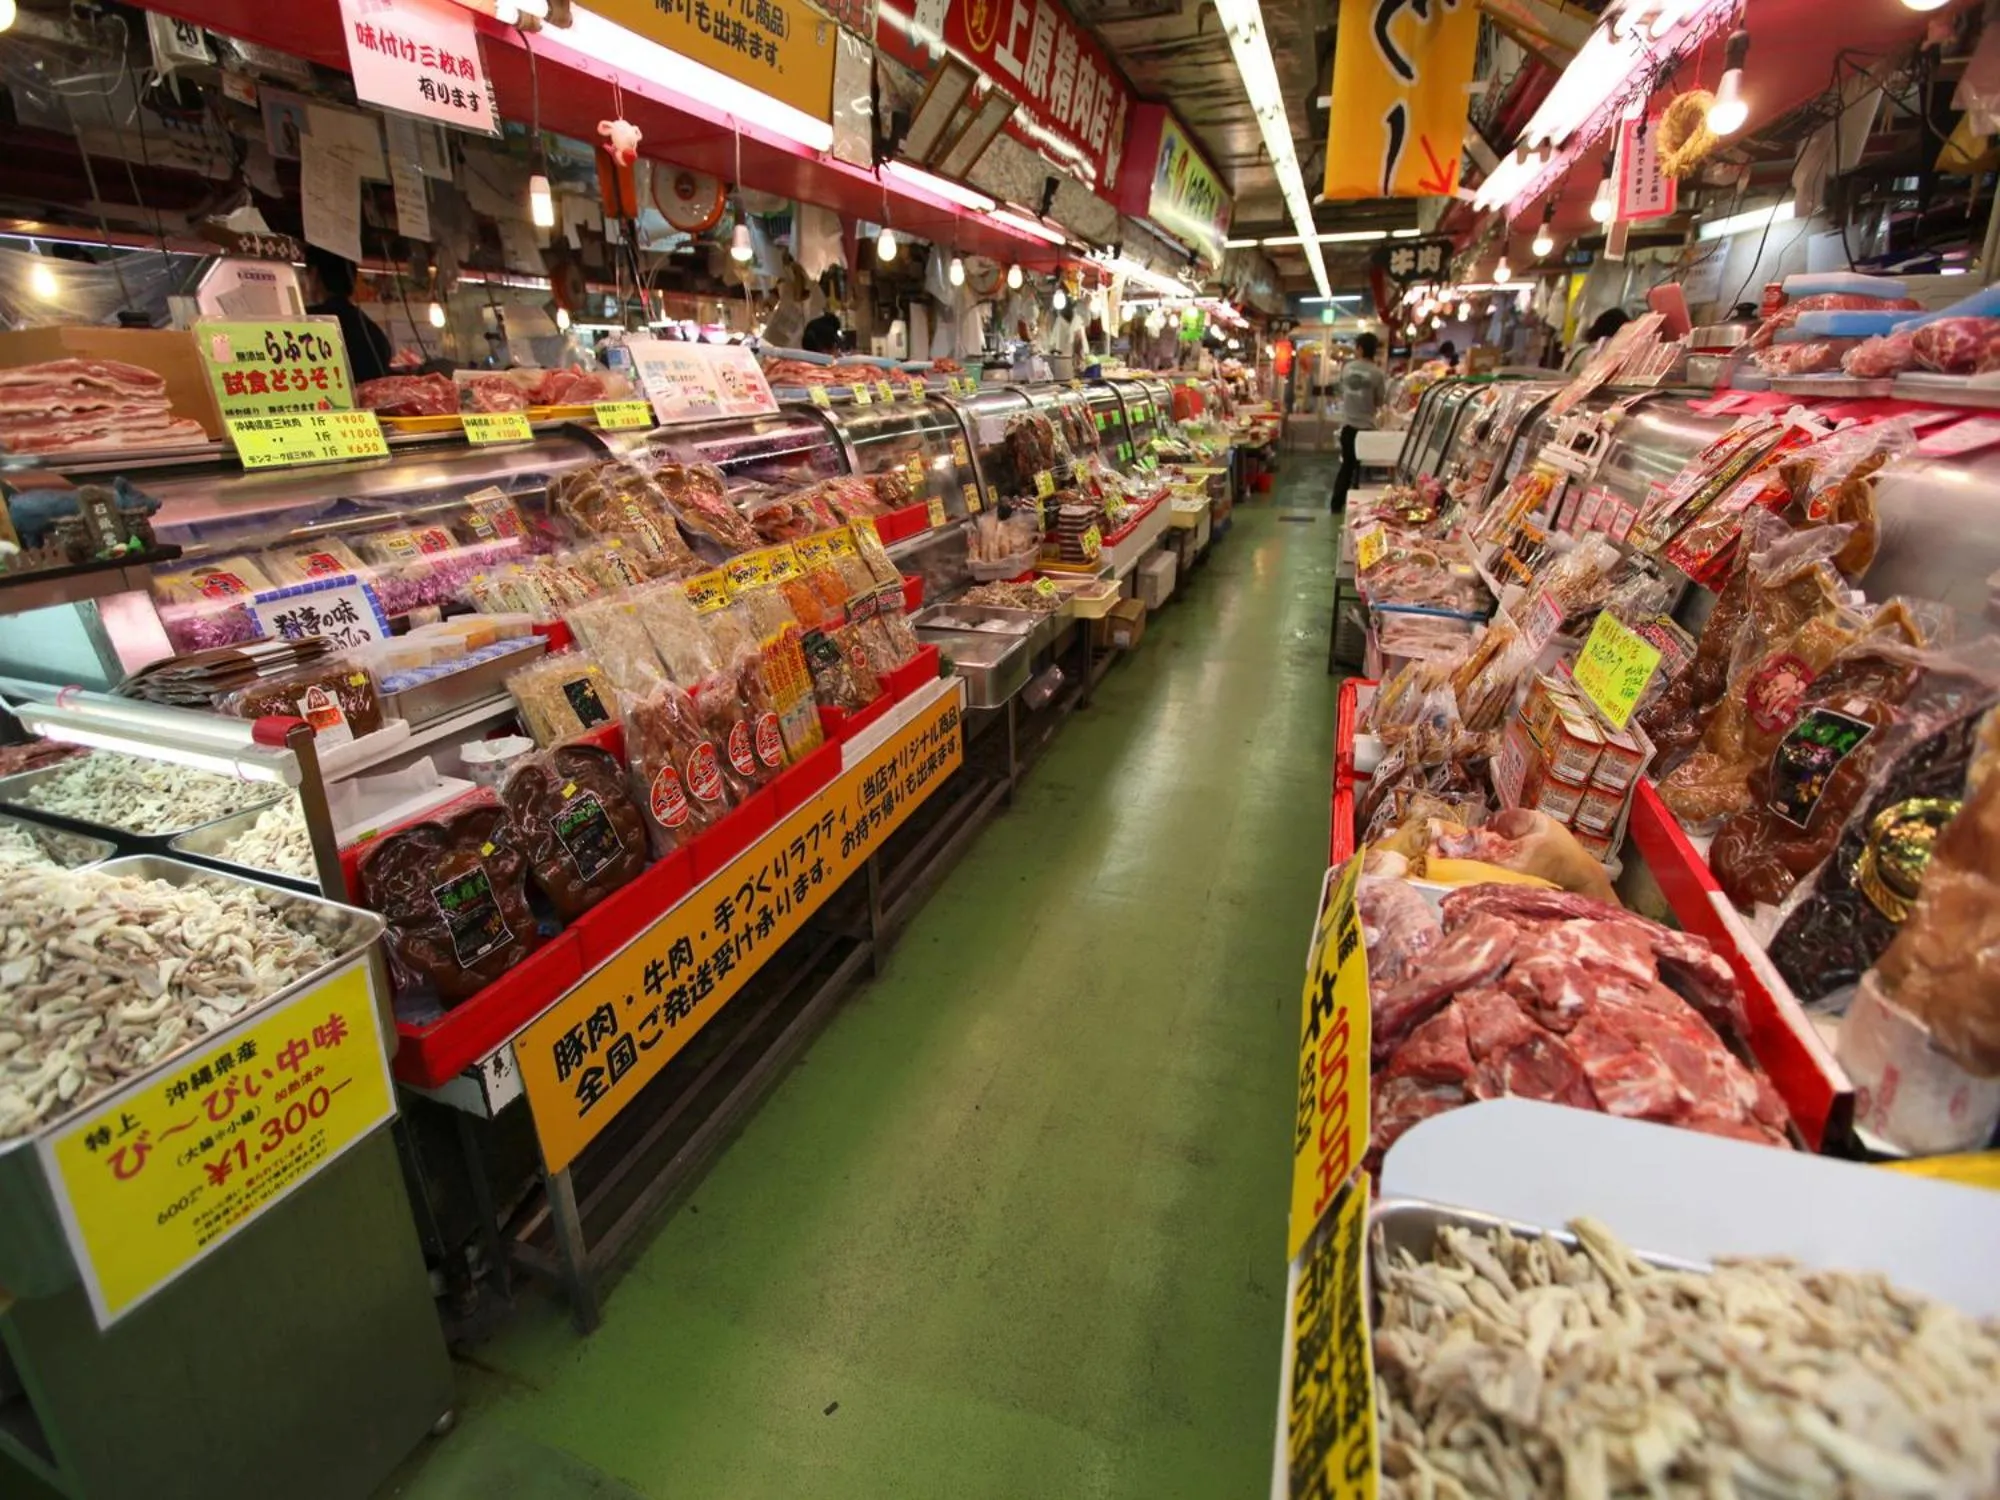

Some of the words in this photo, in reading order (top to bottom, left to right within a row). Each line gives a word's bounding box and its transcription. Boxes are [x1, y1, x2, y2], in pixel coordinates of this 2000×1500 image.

[354, 20, 476, 82] 味付け三枚肉
[418, 75, 481, 112] 有ります
[994, 0, 1113, 155] 上原精肉店
[340, 428, 381, 439] ¥1000
[84, 1112, 141, 1153] 特上
[165, 1039, 258, 1106] 沖縄県産
[1314, 1006, 1350, 1217] 1000円
